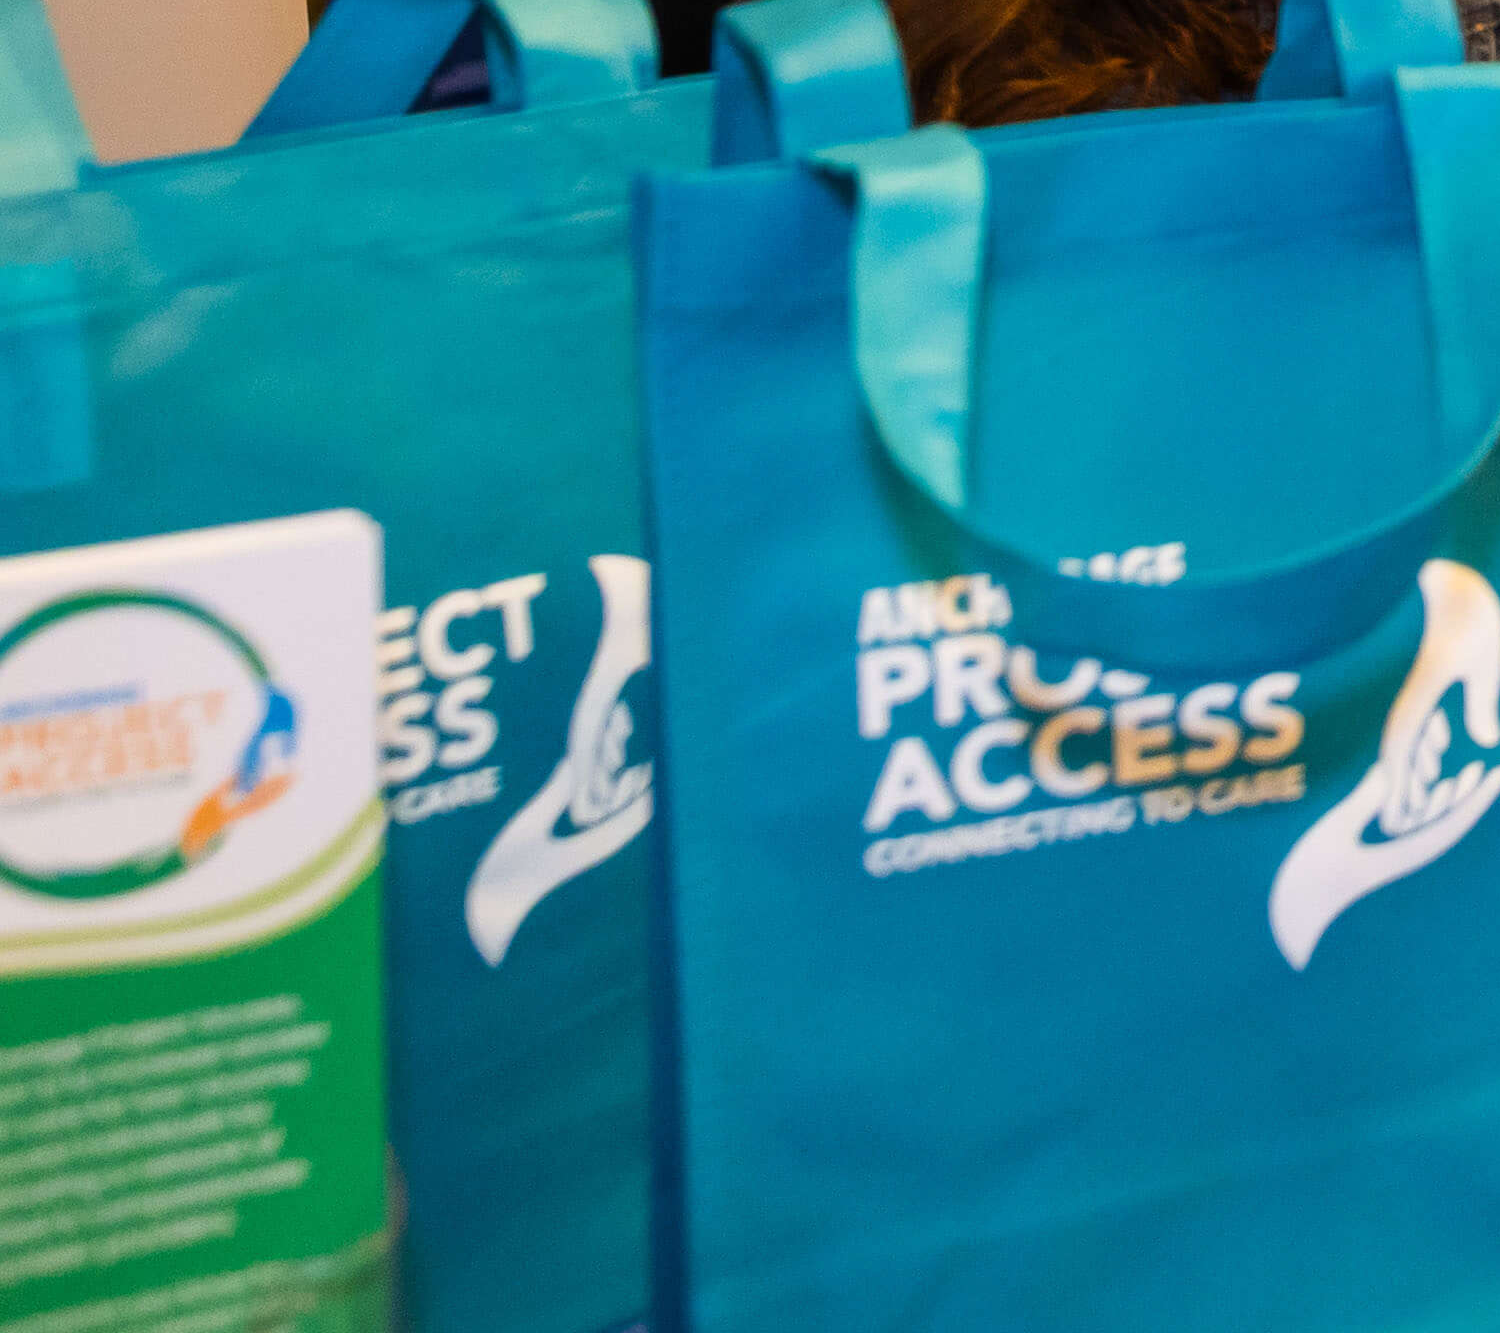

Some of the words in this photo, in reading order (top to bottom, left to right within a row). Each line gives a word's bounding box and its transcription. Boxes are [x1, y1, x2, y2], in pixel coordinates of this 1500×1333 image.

[863, 671, 1306, 833] ACCESS
[863, 796, 1137, 879] CONNECTING
[1141, 786, 1194, 826] TO
[1198, 764, 1307, 816] CARE
